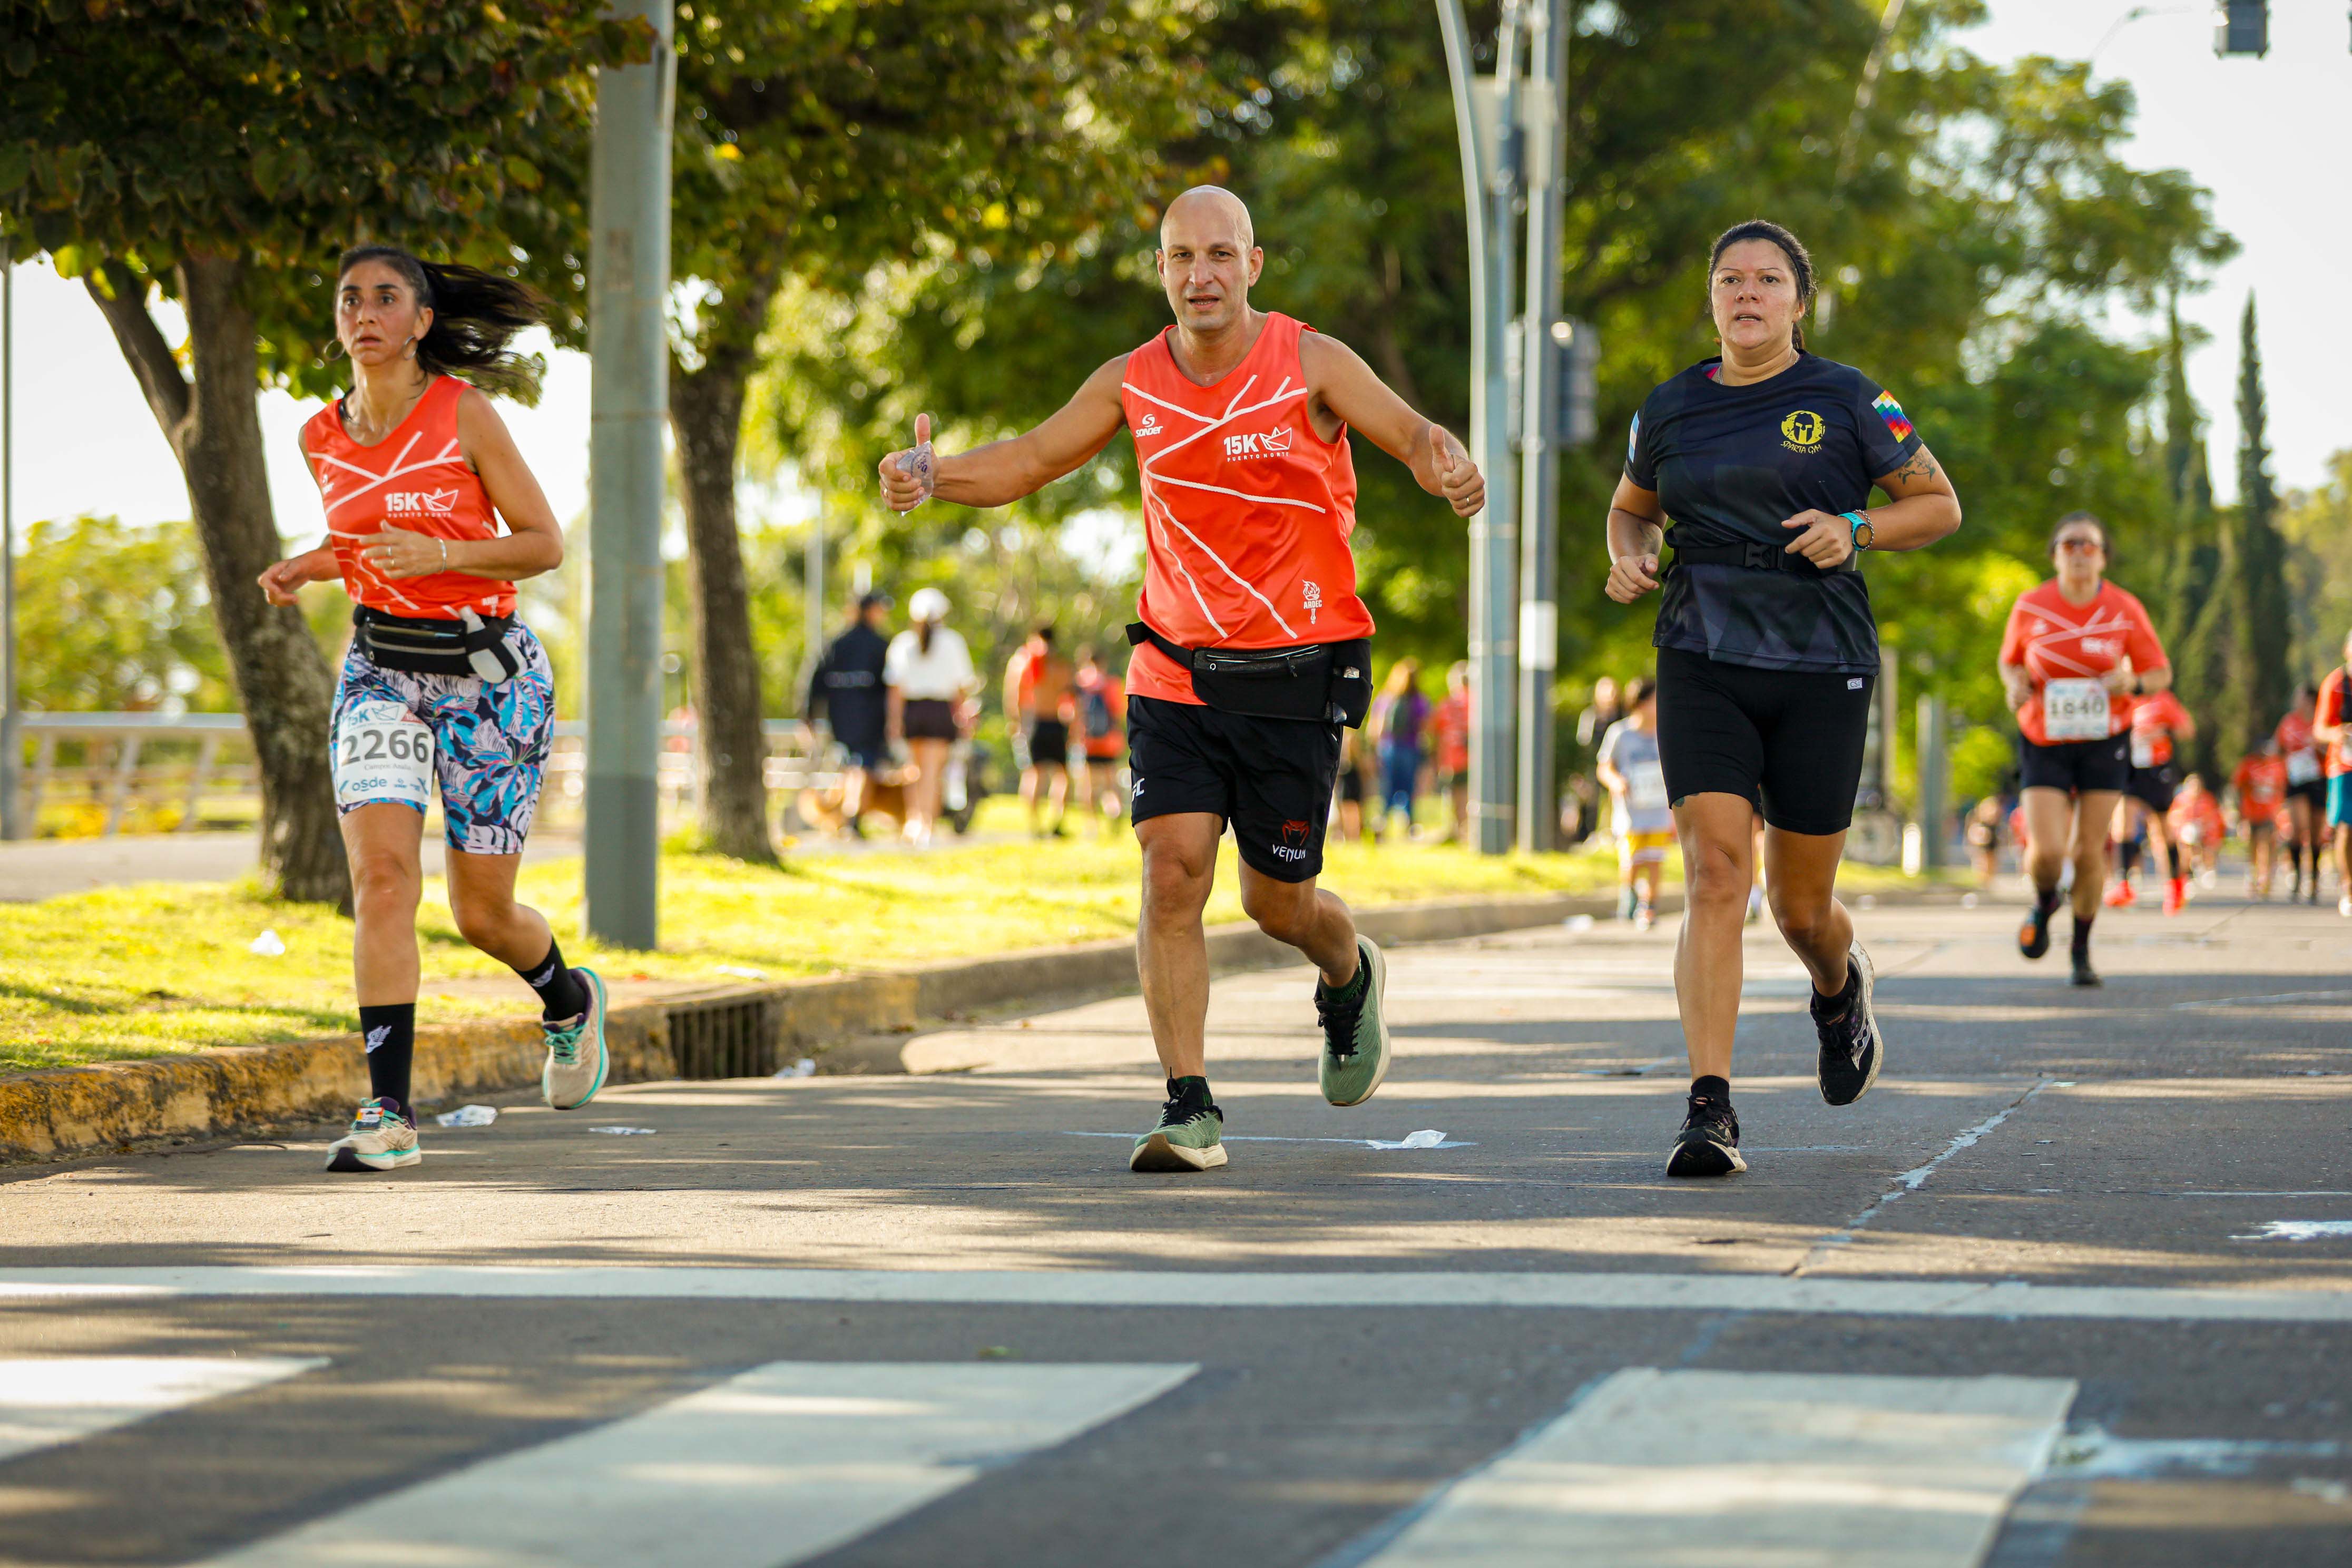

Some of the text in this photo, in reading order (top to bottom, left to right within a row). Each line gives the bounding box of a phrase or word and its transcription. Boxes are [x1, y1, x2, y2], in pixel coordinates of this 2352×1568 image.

[1223, 434, 1259, 455] 15K
[1780, 440, 1822, 454] SPARTA GYM
[1227, 454, 1260, 462] PUERTO
[384, 492, 421, 511] 15K
[1304, 600, 1322, 609] ARDEC
[341, 729, 430, 766] 2266
[352, 776, 388, 791] osde
[1272, 844, 1306, 862] VENUM
